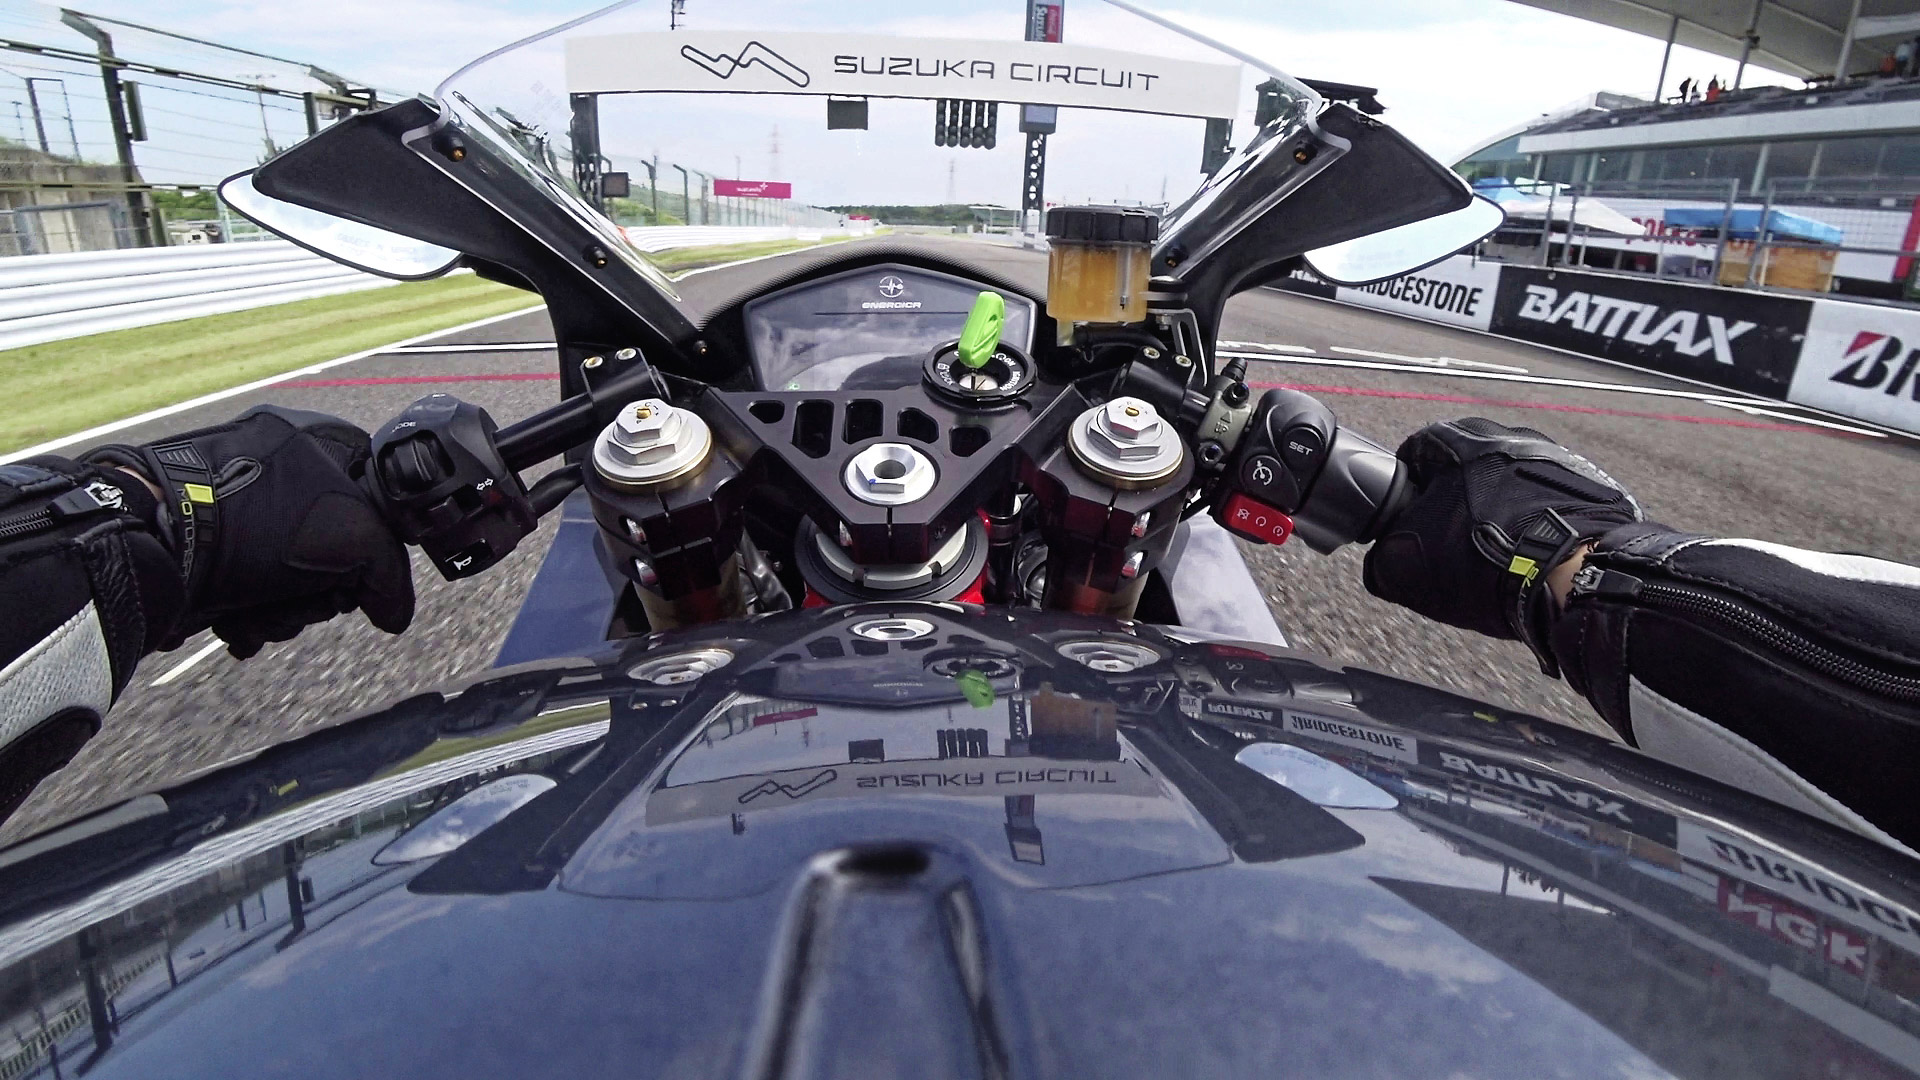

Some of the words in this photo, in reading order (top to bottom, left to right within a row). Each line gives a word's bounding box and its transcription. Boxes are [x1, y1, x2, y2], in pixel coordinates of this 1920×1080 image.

[833, 55, 995, 80] SUZUKA
[1010, 62, 1159, 91] CIRCUIT
[861, 301, 922, 309] ENERGICA
[1350, 276, 1484, 317] DGESTONE
[1518, 283, 1757, 366] BATTLAX
[1288, 441, 1313, 456] SET
